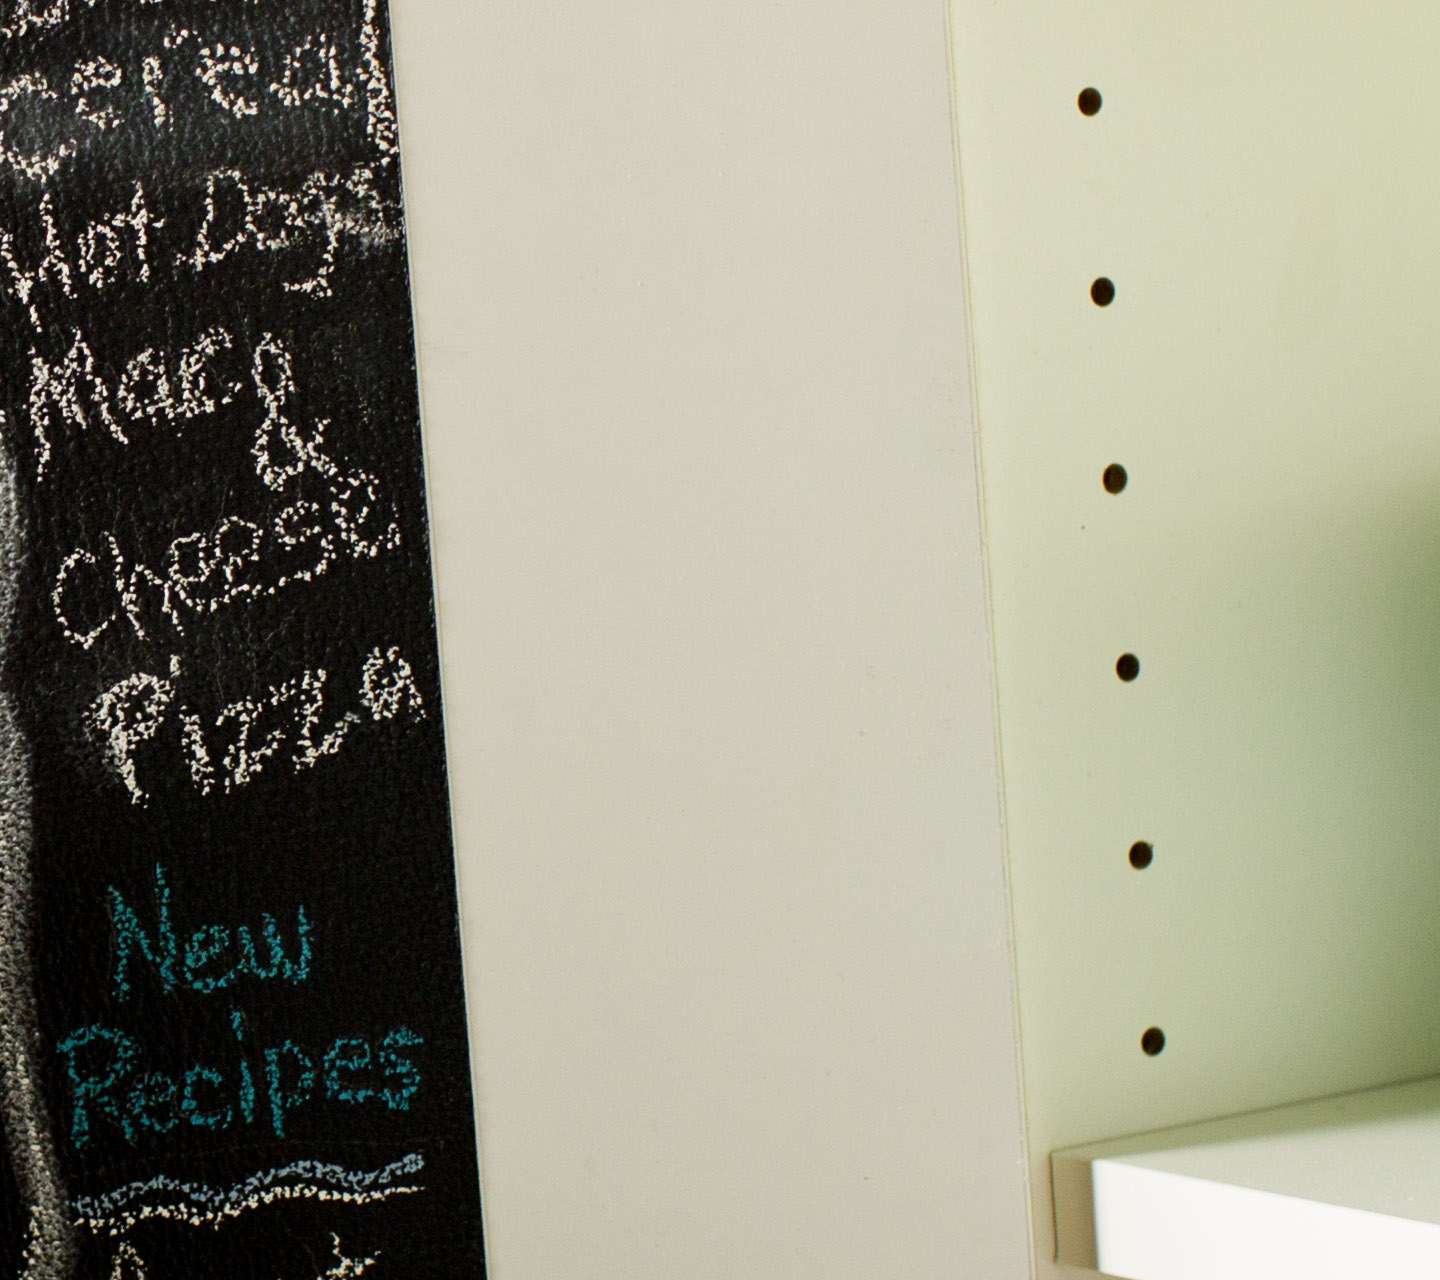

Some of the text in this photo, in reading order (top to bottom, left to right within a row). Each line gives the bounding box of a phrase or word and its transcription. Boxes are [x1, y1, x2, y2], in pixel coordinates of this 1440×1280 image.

[173, 166, 406, 300] Dogs
[24, 327, 336, 491] Mac &
[52, 467, 400, 650] Cheese
[82, 646, 426, 808] Pizza
[108, 862, 315, 1002] New
[56, 1004, 424, 1149] Recipes
